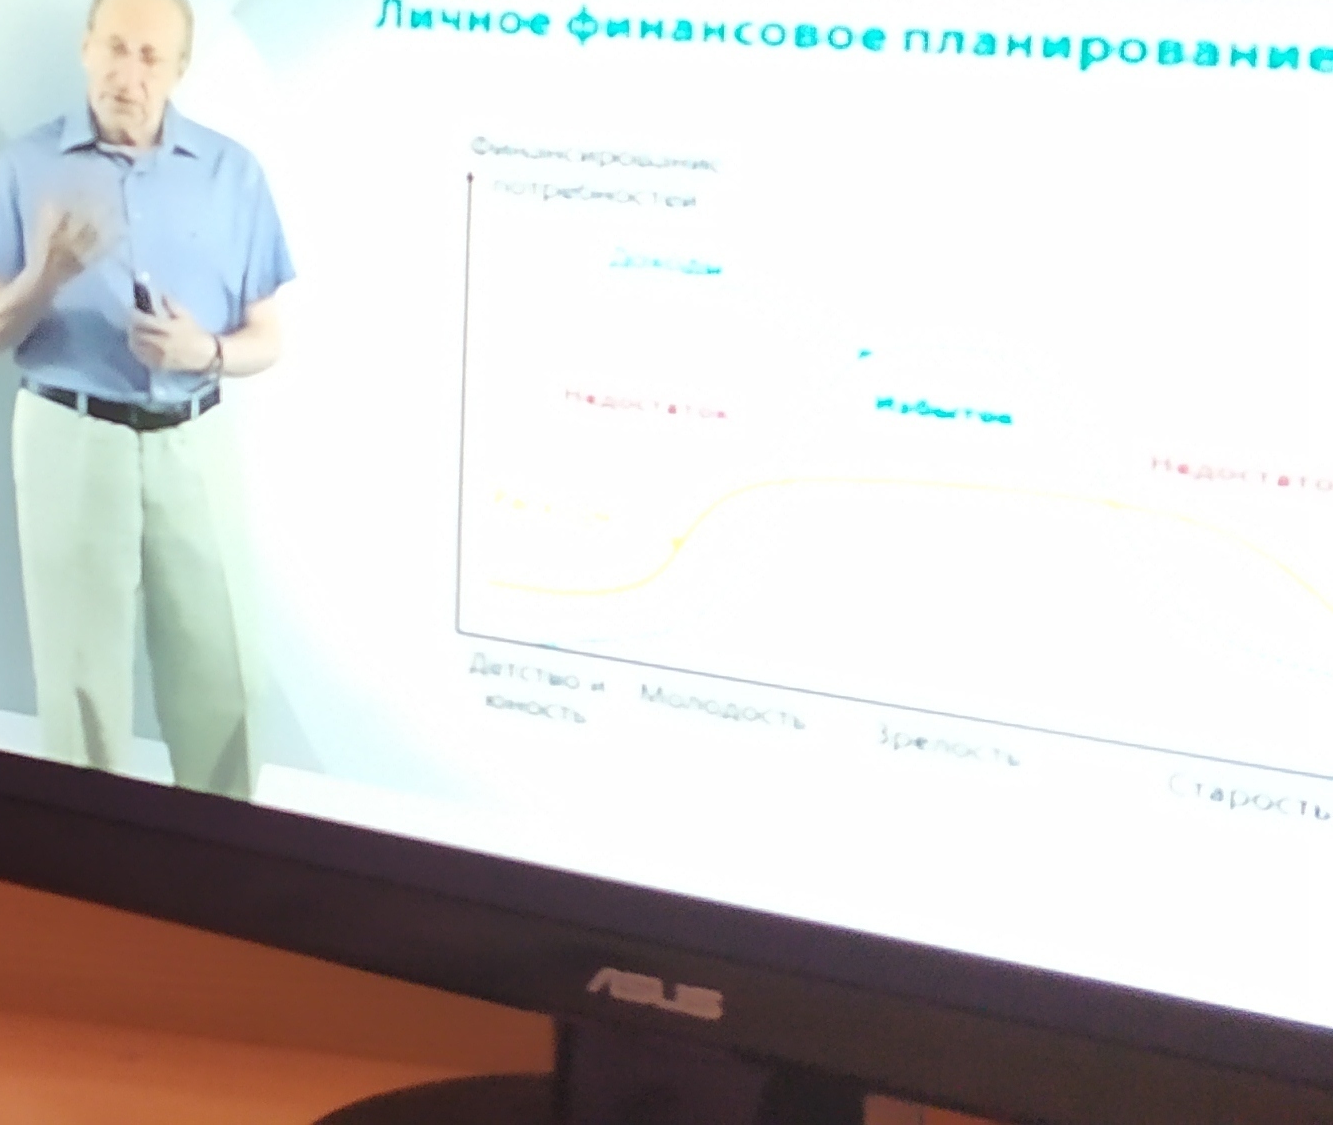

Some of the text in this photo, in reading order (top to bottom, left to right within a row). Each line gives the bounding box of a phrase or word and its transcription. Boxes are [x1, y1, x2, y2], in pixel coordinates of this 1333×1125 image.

[566, 4, 887, 52] финансовое
[902, 27, 1333, 73] планирование
[469, 652, 580, 690] Детство
[485, 695, 587, 724] юность
[640, 683, 807, 731] Молодость
[878, 722, 1021, 767] Зрелость
[1168, 772, 1331, 821] Старость
[586, 966, 724, 1021] ASUS
